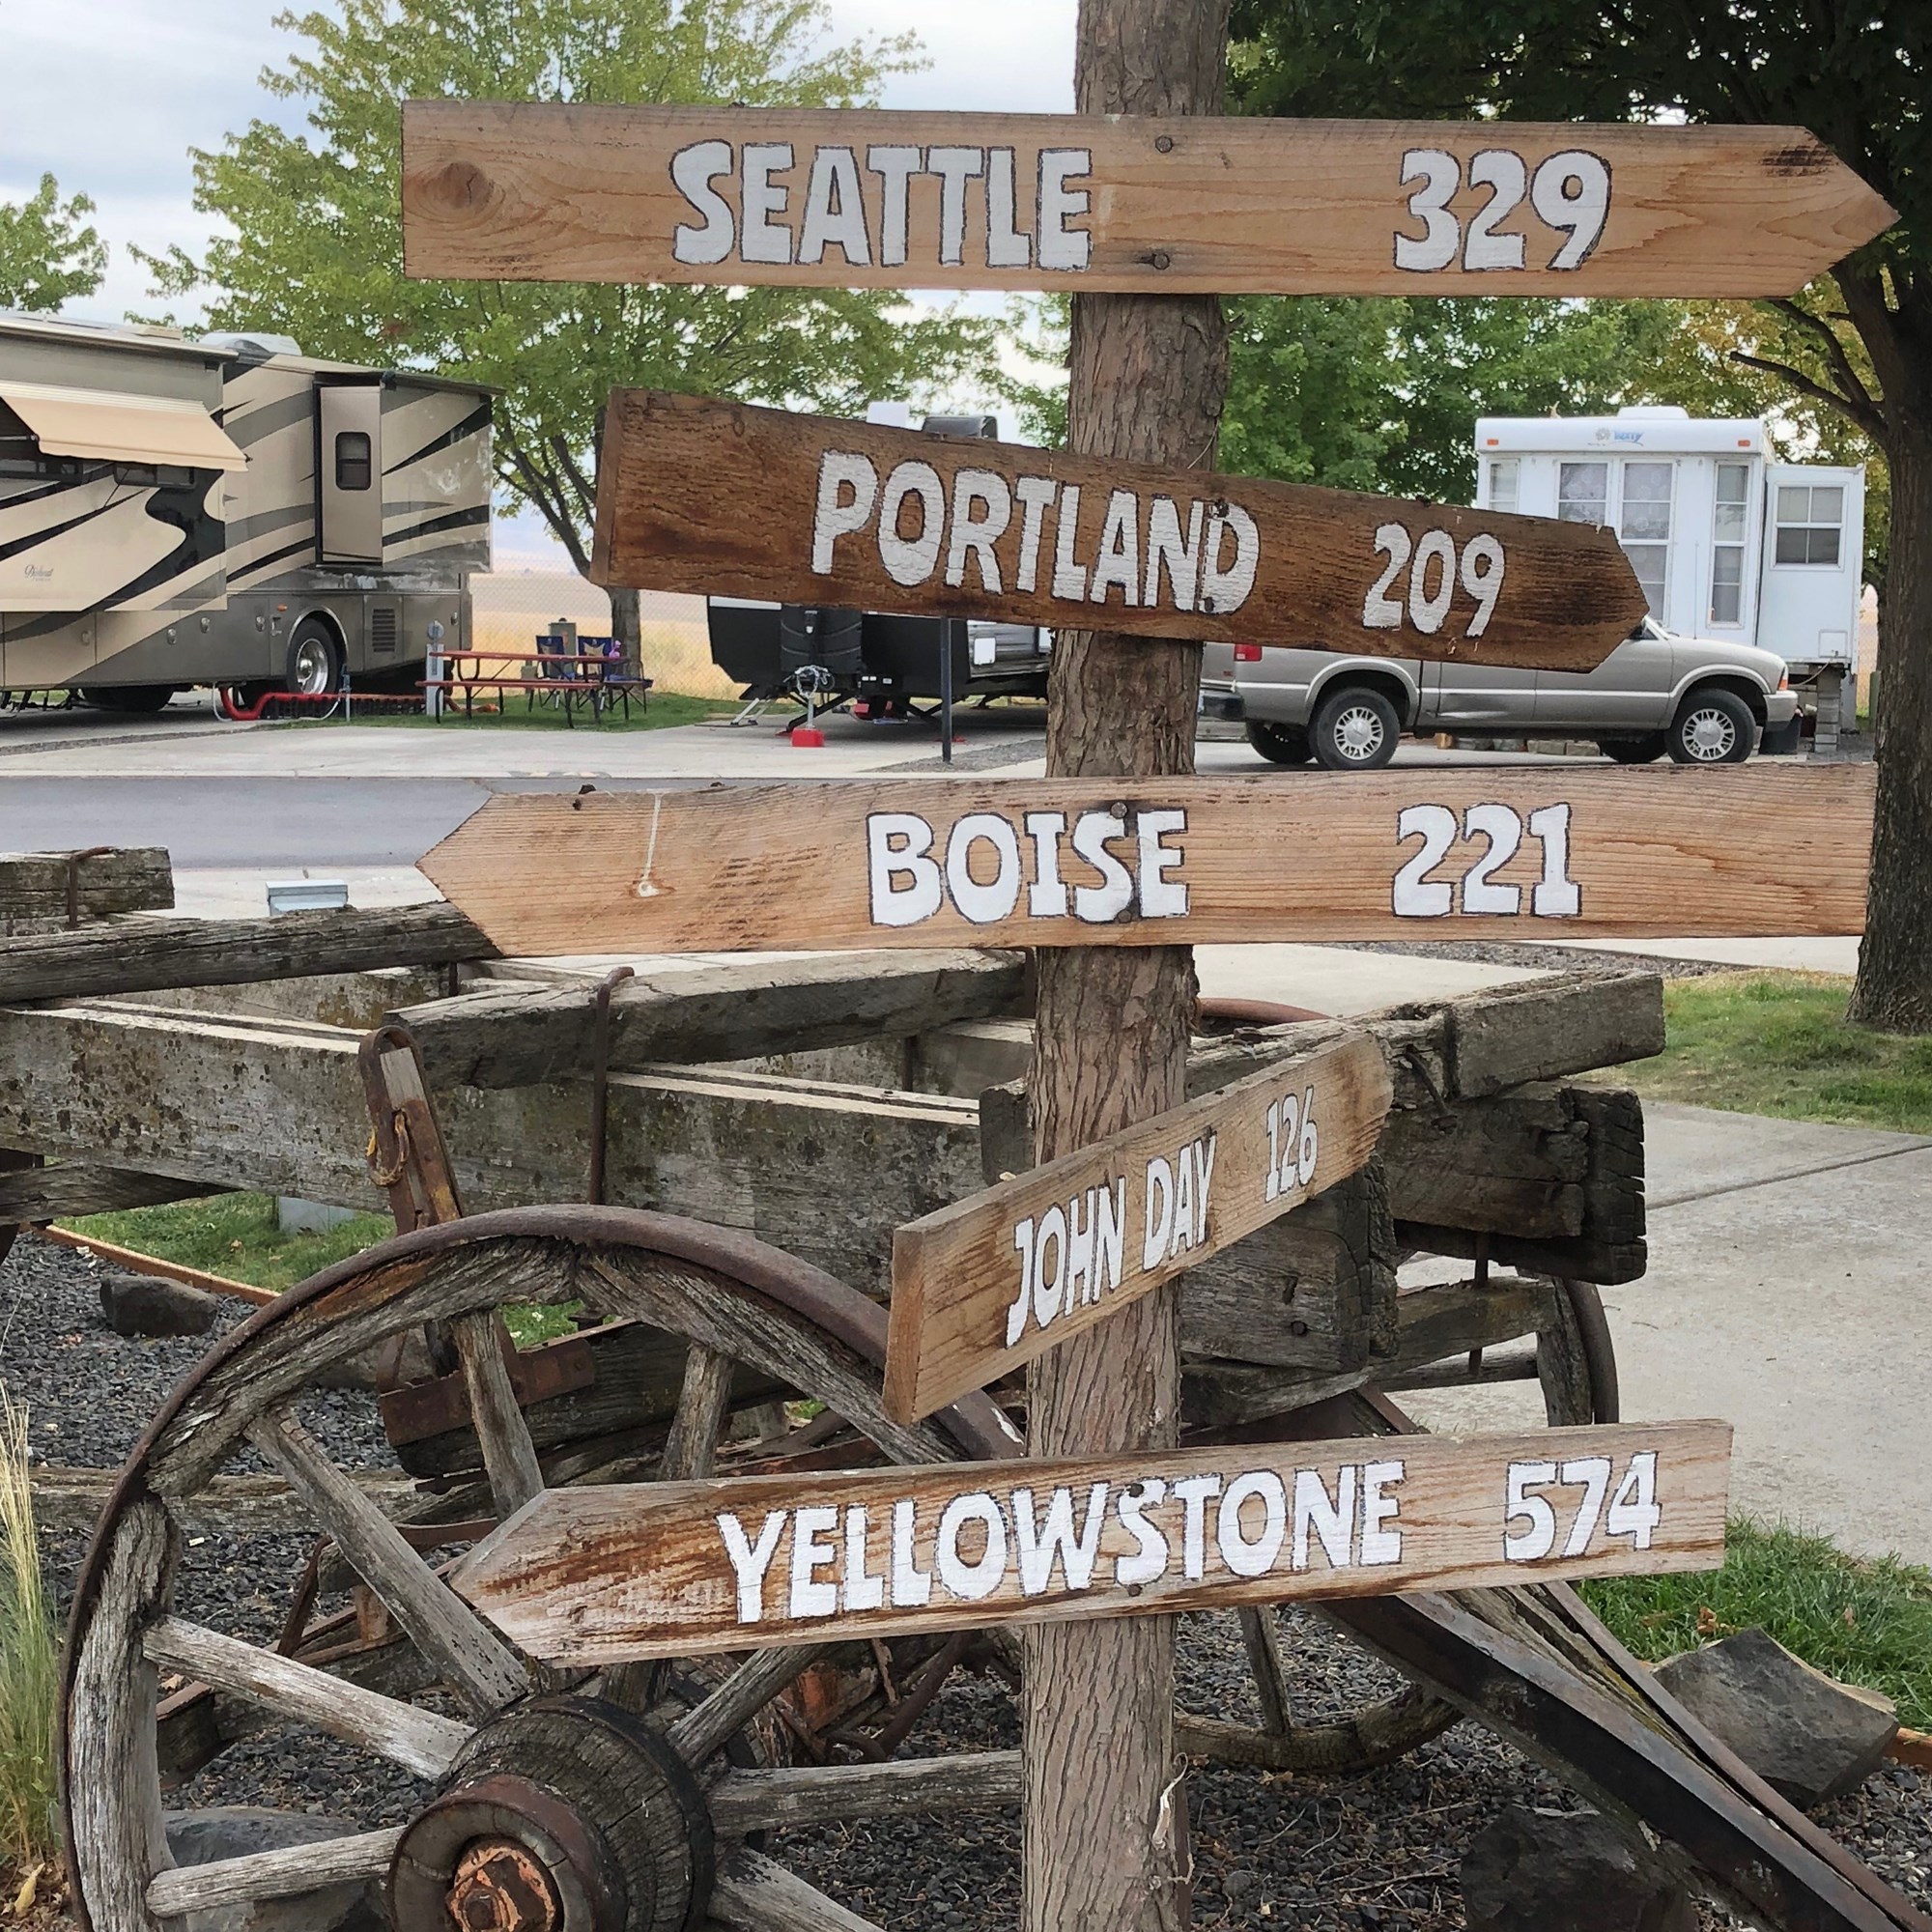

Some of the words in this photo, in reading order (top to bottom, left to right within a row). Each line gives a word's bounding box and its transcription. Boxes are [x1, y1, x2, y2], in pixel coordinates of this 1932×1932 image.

[668, 138, 1094, 271] SEATTLE
[1393, 148, 1611, 271] 329
[810, 450, 1259, 614] PORTLAND
[1362, 524, 1505, 639] 209
[867, 809, 1188, 925] BOISE
[1393, 803, 1581, 919] 221
[1005, 1176, 1126, 1349] JOHN
[1142, 1130, 1217, 1271] DAY
[1264, 1086, 1319, 1203] 126
[716, 1461, 1406, 1625] YELLOWSTONE
[1503, 1451, 1662, 1561] 574
